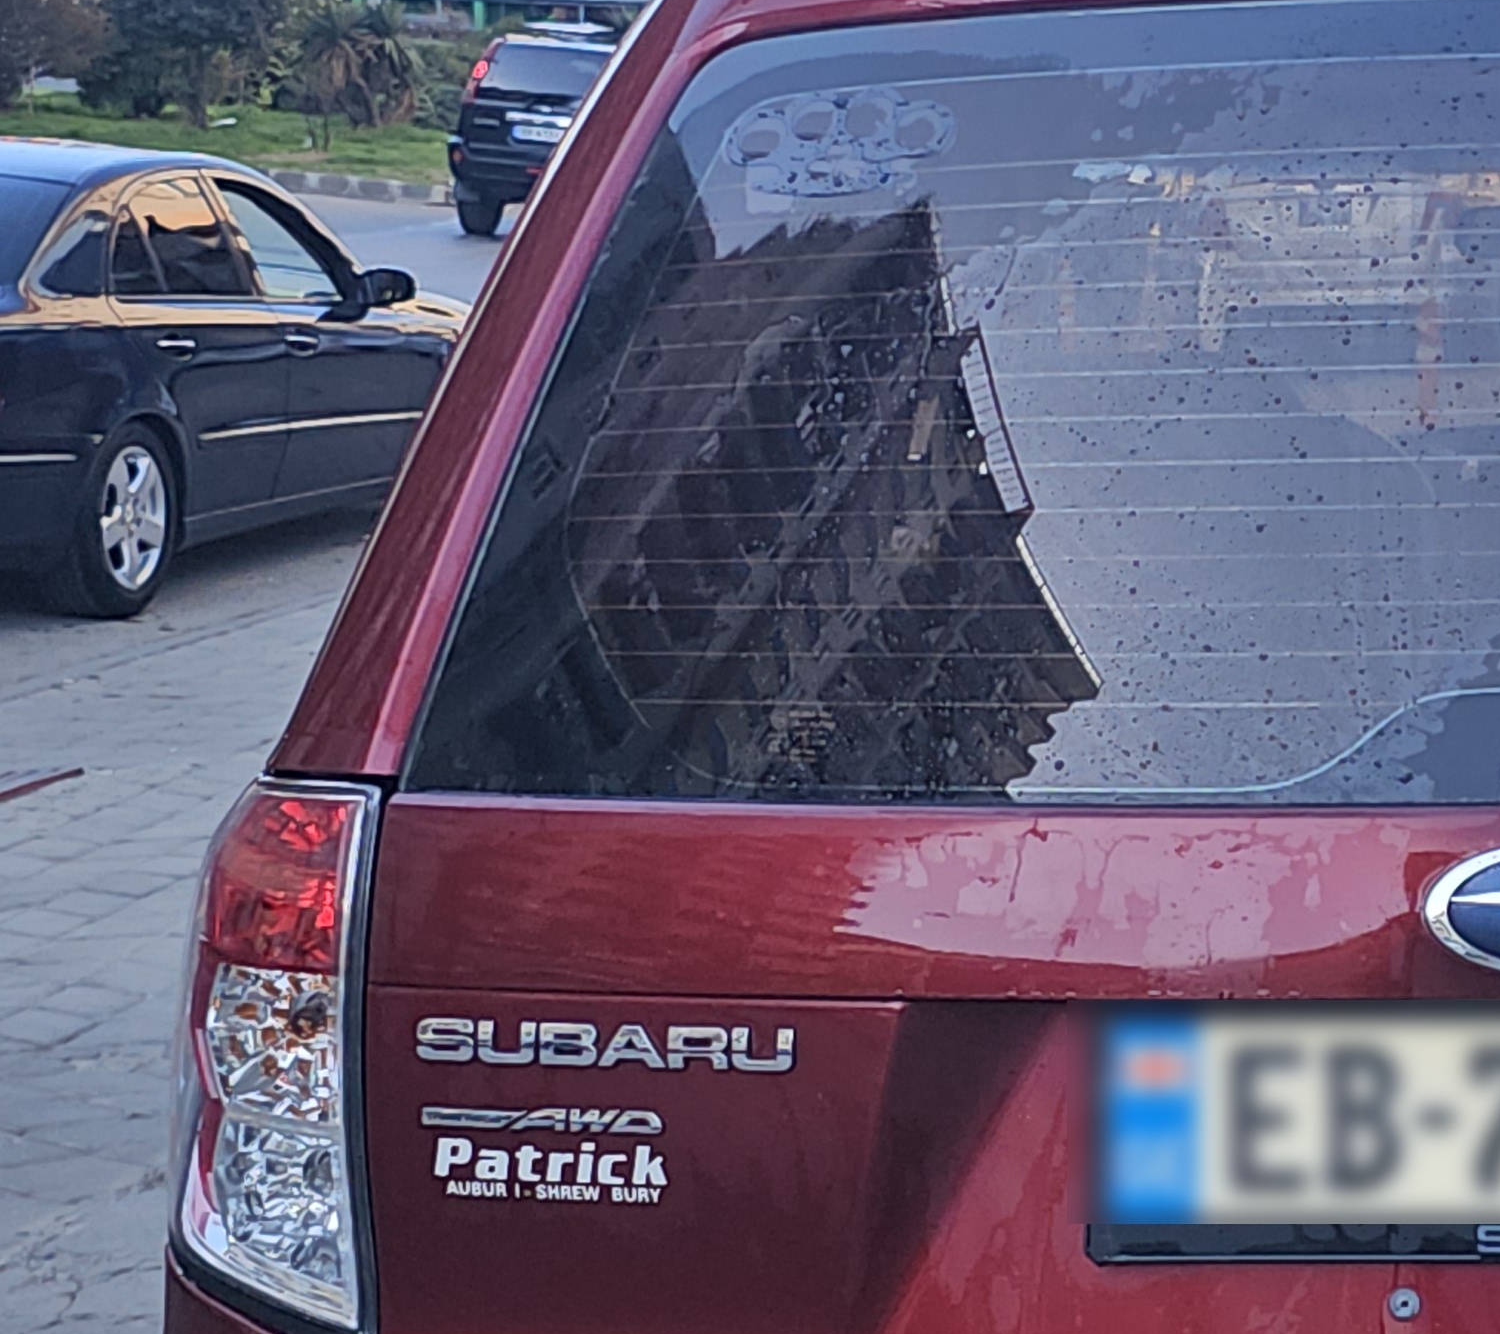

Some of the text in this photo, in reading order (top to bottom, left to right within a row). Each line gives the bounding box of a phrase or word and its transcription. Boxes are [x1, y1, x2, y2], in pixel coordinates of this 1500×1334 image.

[416, 1017, 794, 1071] SUBARU
[509, 1108, 662, 1134] AWD
[433, 1137, 668, 1185] Patrick
